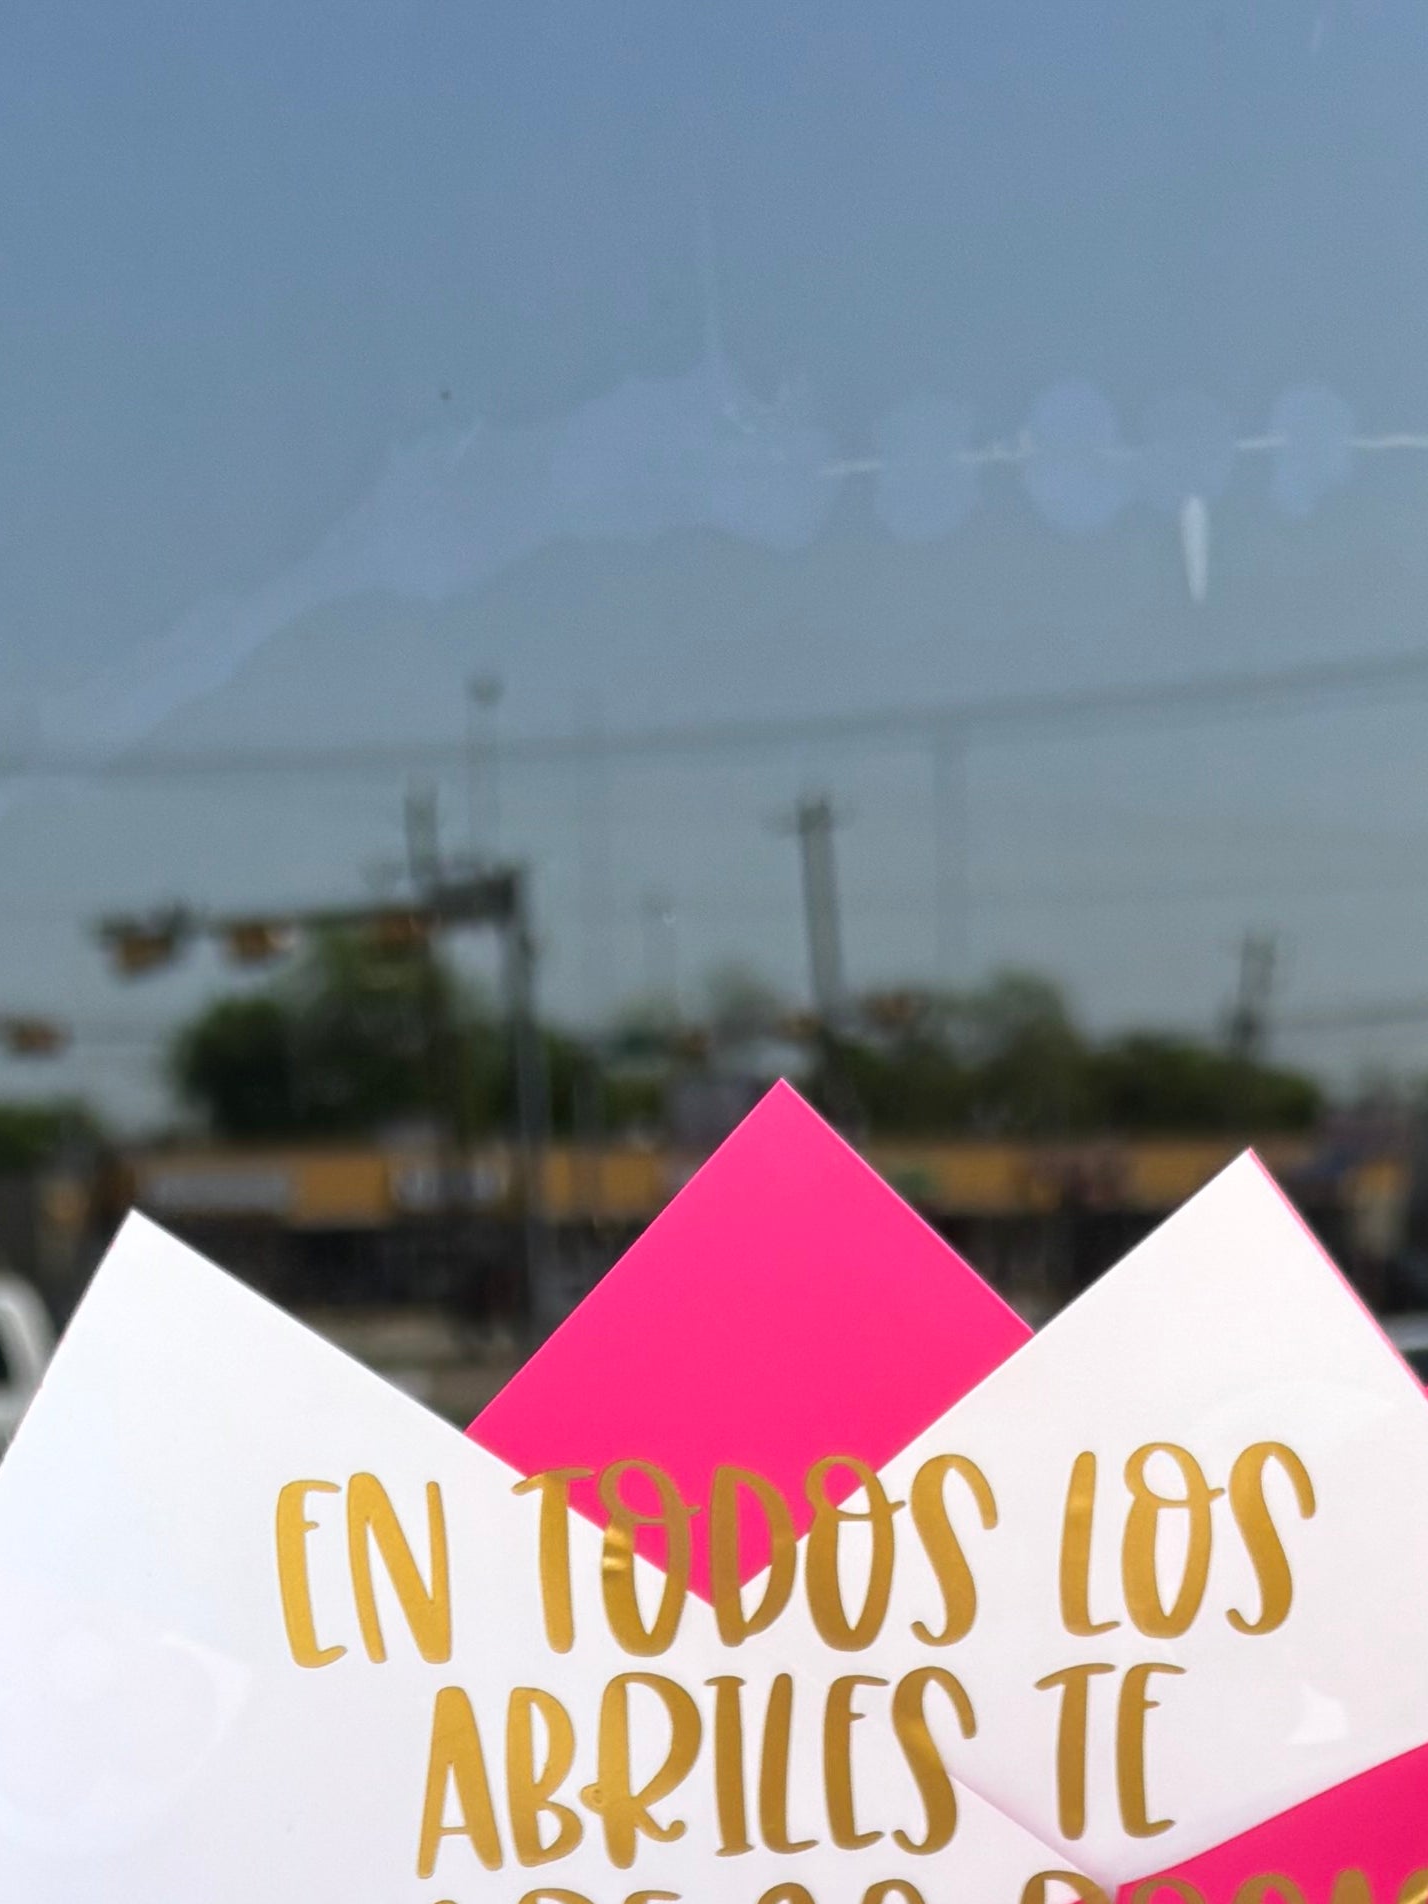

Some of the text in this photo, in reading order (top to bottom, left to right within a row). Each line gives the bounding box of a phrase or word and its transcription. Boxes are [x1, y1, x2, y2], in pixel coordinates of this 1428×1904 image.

[275, 1441, 1316, 1668] EN TODOS LOS
[416, 1661, 1188, 1879] ABRILES TE
